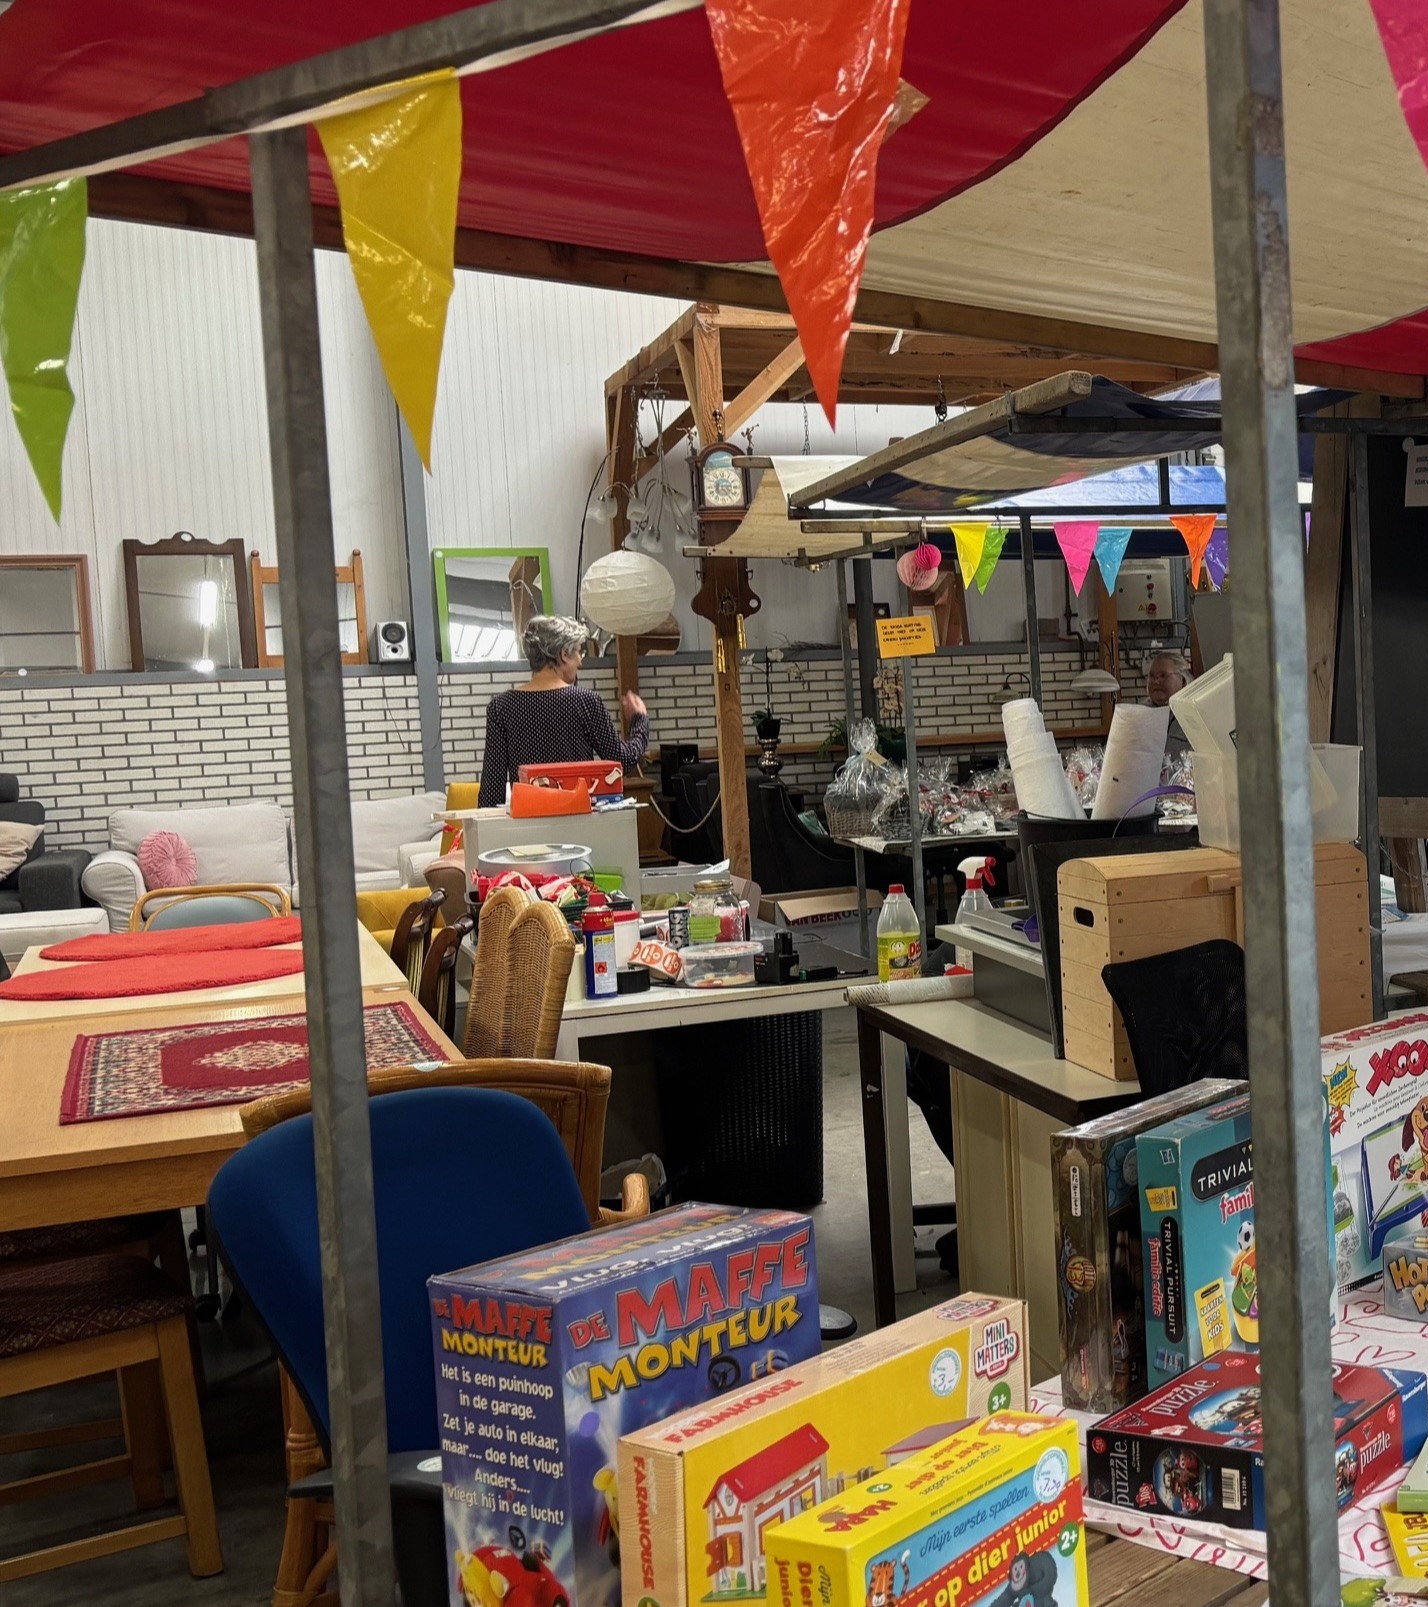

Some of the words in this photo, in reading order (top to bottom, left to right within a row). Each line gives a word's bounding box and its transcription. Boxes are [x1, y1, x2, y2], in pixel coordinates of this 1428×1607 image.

[1198, 1159, 1254, 1192] TRIVIAL
[1148, 1237, 1162, 1280] familie
[1164, 1222, 1173, 1273] TRIVIAL
[566, 1311, 610, 1349] DE
[615, 1225, 811, 1348] MAFFE
[1166, 1278, 1177, 1335] PURSUIT
[452, 1295, 554, 1344] MAFFE
[985, 1322, 1005, 1346] MINI
[1207, 1322, 1224, 1341] KIDS
[441, 1329, 549, 1368] MONTEUR
[588, 1295, 802, 1402] MONTEUR
[977, 1336, 1015, 1369] MATTERS
[441, 1363, 459, 1382] Het
[462, 1367, 472, 1384] is
[474, 1373, 496, 1390] een
[498, 1375, 554, 1400] puinhoop
[992, 1393, 1007, 1411] 3+
[459, 1389, 471, 1407] in
[473, 1392, 488, 1410] de
[490, 1399, 537, 1420] garage.
[664, 1378, 804, 1444] FARMHOUSE
[443, 1413, 461, 1431] Zet
[464, 1418, 475, 1435] je
[478, 1421, 503, 1438] auto
[506, 1425, 518, 1442] in
[520, 1427, 560, 1454] elkaar,
[1360, 1430, 1392, 1475] puzzle
[474, 1468, 531, 1494] Anders....
[485, 1448, 507, 1465] doe
[510, 1452, 530, 1470] het
[533, 1457, 564, 1479] vlug!
[445, 1483, 478, 1507] vliegt
[481, 1495, 497, 1513] hij
[499, 1497, 510, 1514] in
[513, 1499, 527, 1516] de
[530, 1505, 564, 1526] lucht!
[633, 1456, 655, 1590] FARMHOUSE
[920, 1526, 953, 1558] Mijn
[953, 1510, 987, 1538] eerste
[989, 1485, 1030, 1522] spellen
[934, 1575, 963, 1607] op
[967, 1543, 1009, 1585] dier
[1014, 1498, 1068, 1549] junior
[1060, 1530, 1079, 1551] 2+
